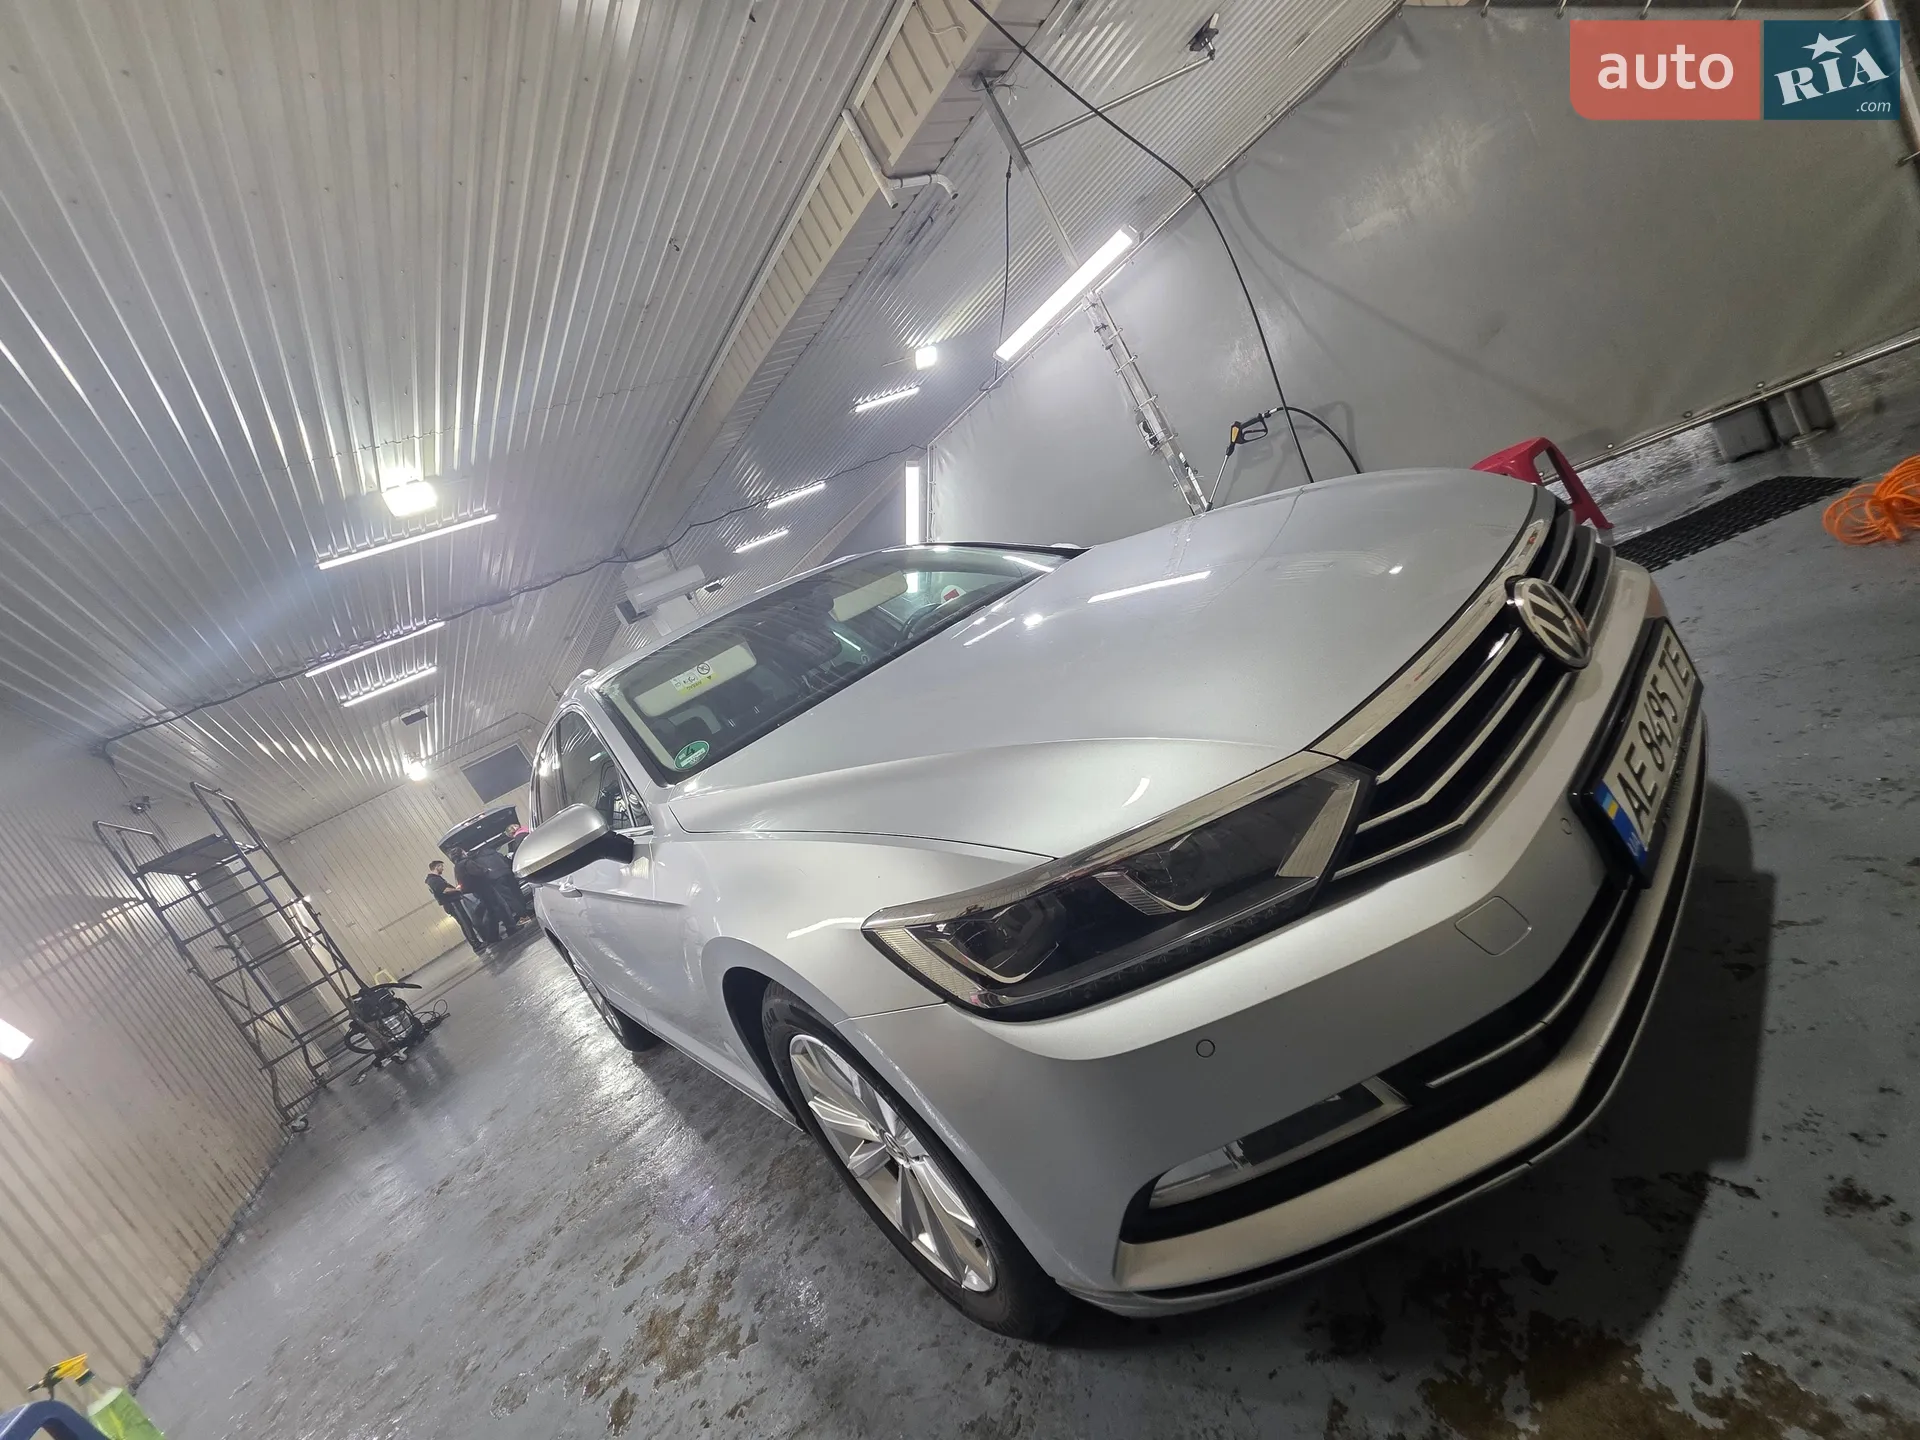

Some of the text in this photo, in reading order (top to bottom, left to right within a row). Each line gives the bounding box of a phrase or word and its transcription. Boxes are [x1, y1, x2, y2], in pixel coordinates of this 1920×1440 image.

[1617, 636, 1690, 834] AE 8495 TE
